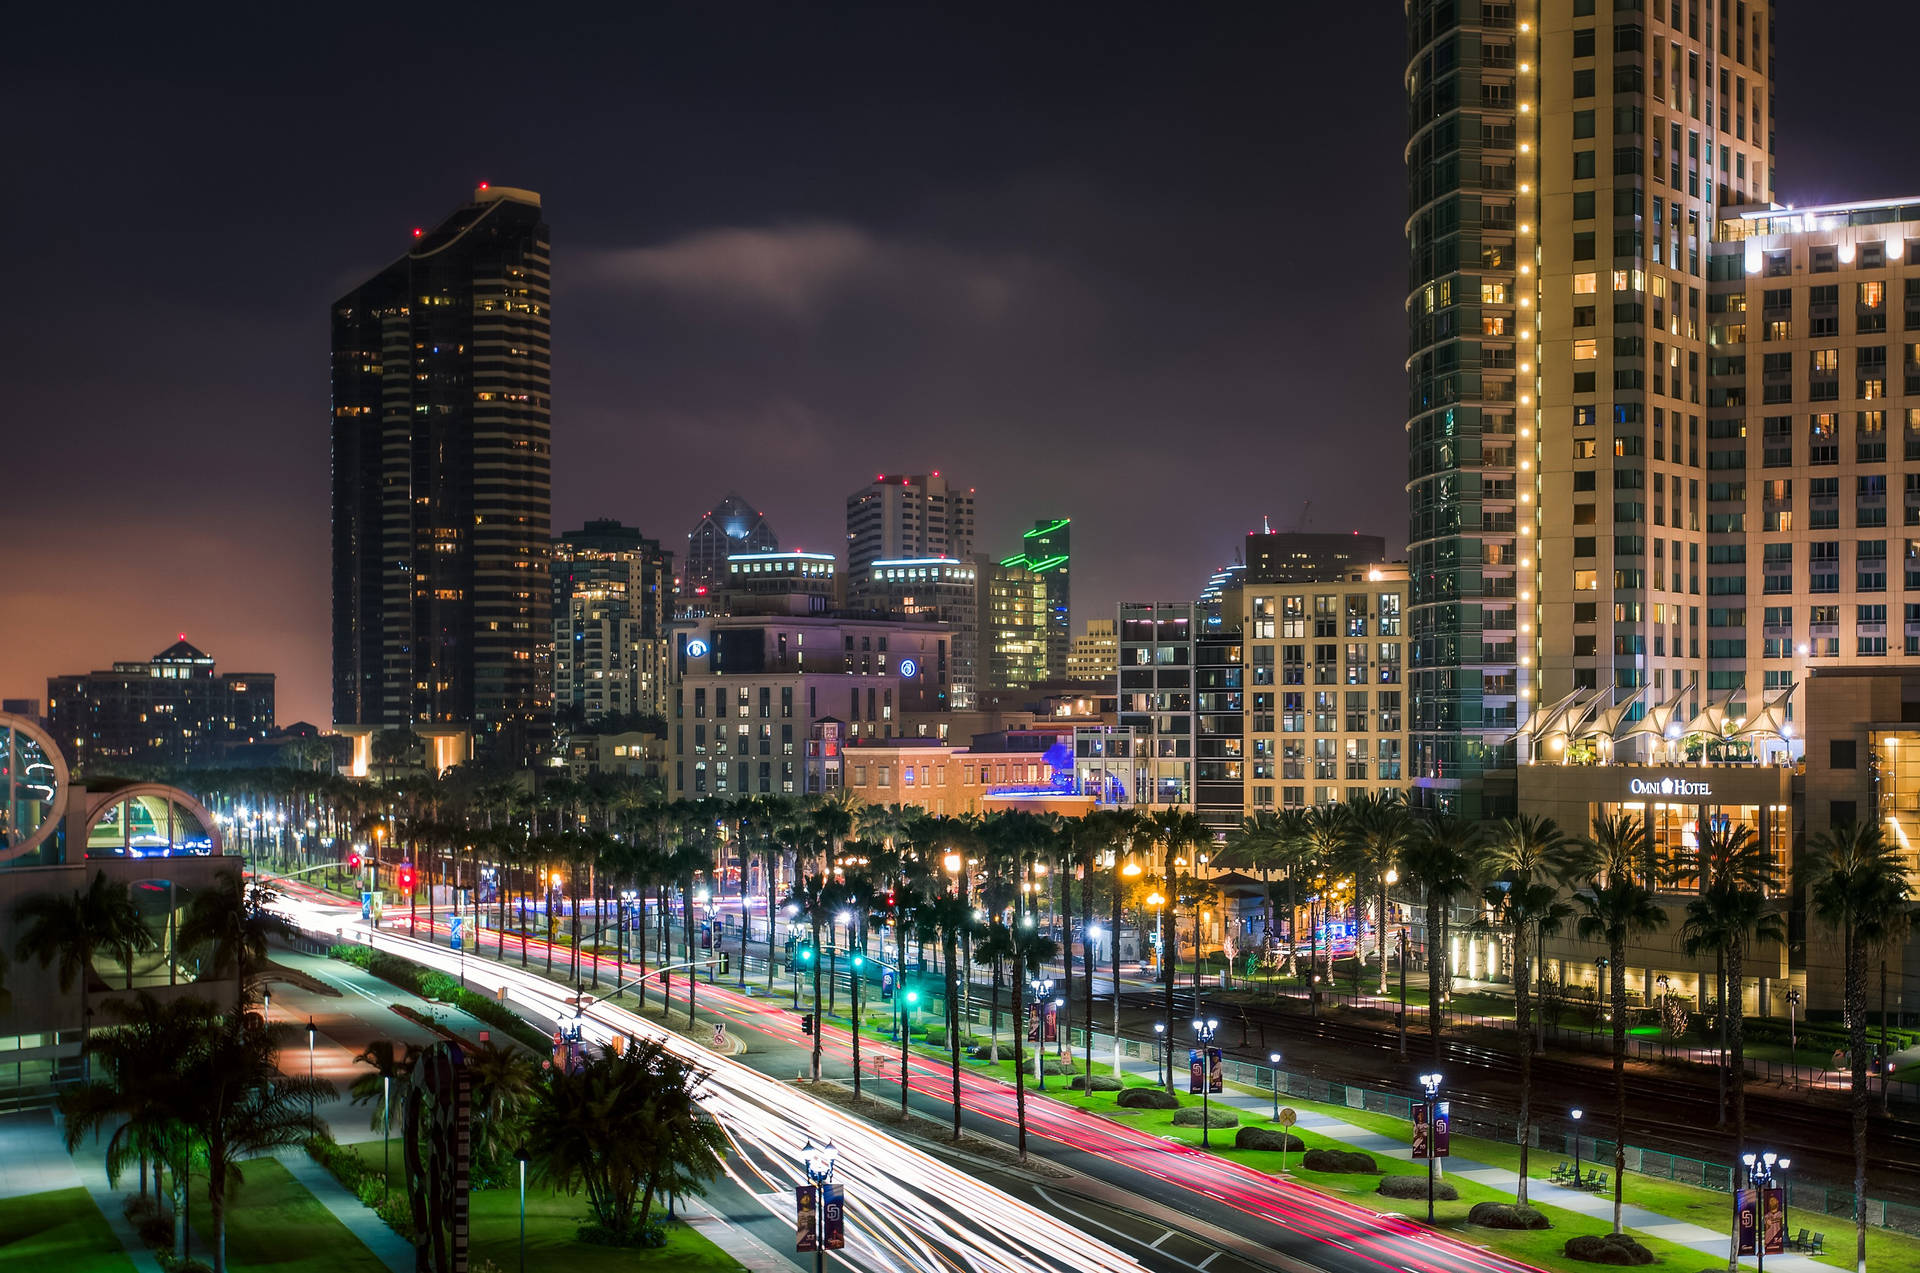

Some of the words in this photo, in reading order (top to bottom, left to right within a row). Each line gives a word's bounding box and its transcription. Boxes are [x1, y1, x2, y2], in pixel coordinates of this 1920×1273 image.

[1630, 778, 1660, 794] OMNI
[1674, 779, 1712, 796] HOTEL
[1436, 1119, 1447, 1134] SD
[827, 1203, 840, 1221] SD
[1741, 1210, 1753, 1228] SD
